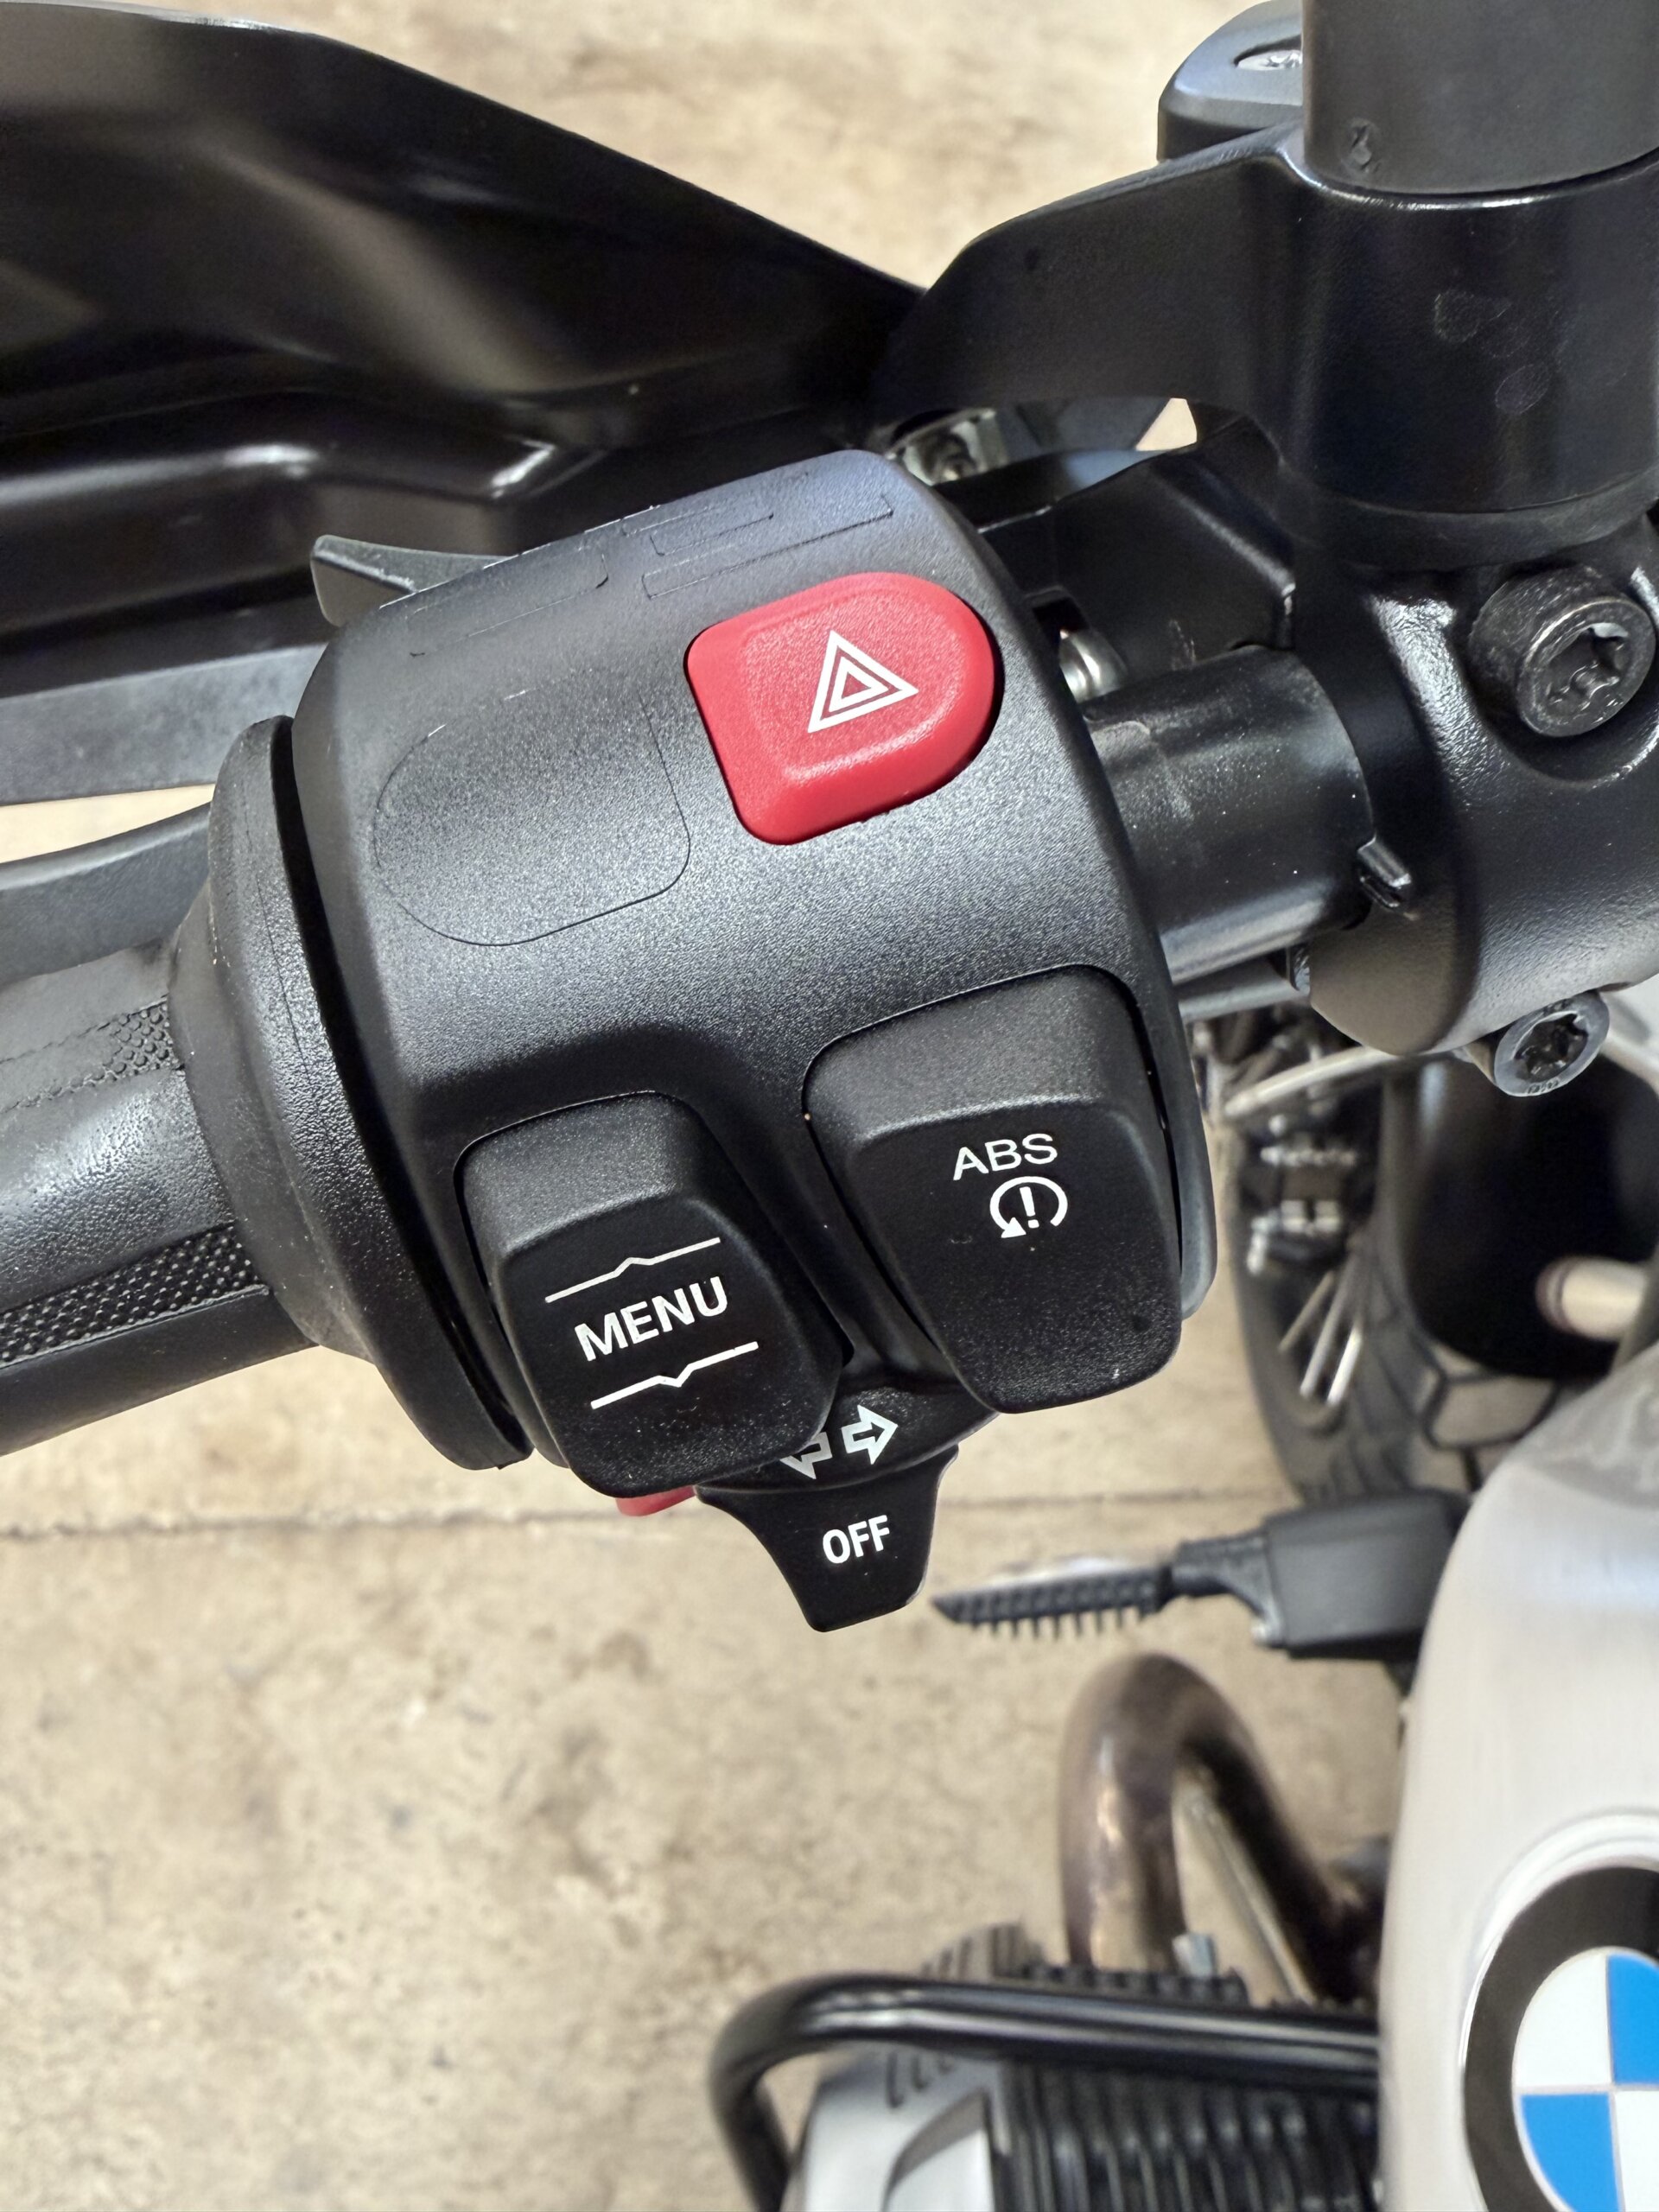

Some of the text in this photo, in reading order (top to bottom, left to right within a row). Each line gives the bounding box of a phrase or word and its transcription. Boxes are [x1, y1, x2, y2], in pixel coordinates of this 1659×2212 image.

[952, 1133, 1058, 1181] ABS
[574, 1275, 728, 1362] MENU
[822, 1514, 890, 1565] OFF
